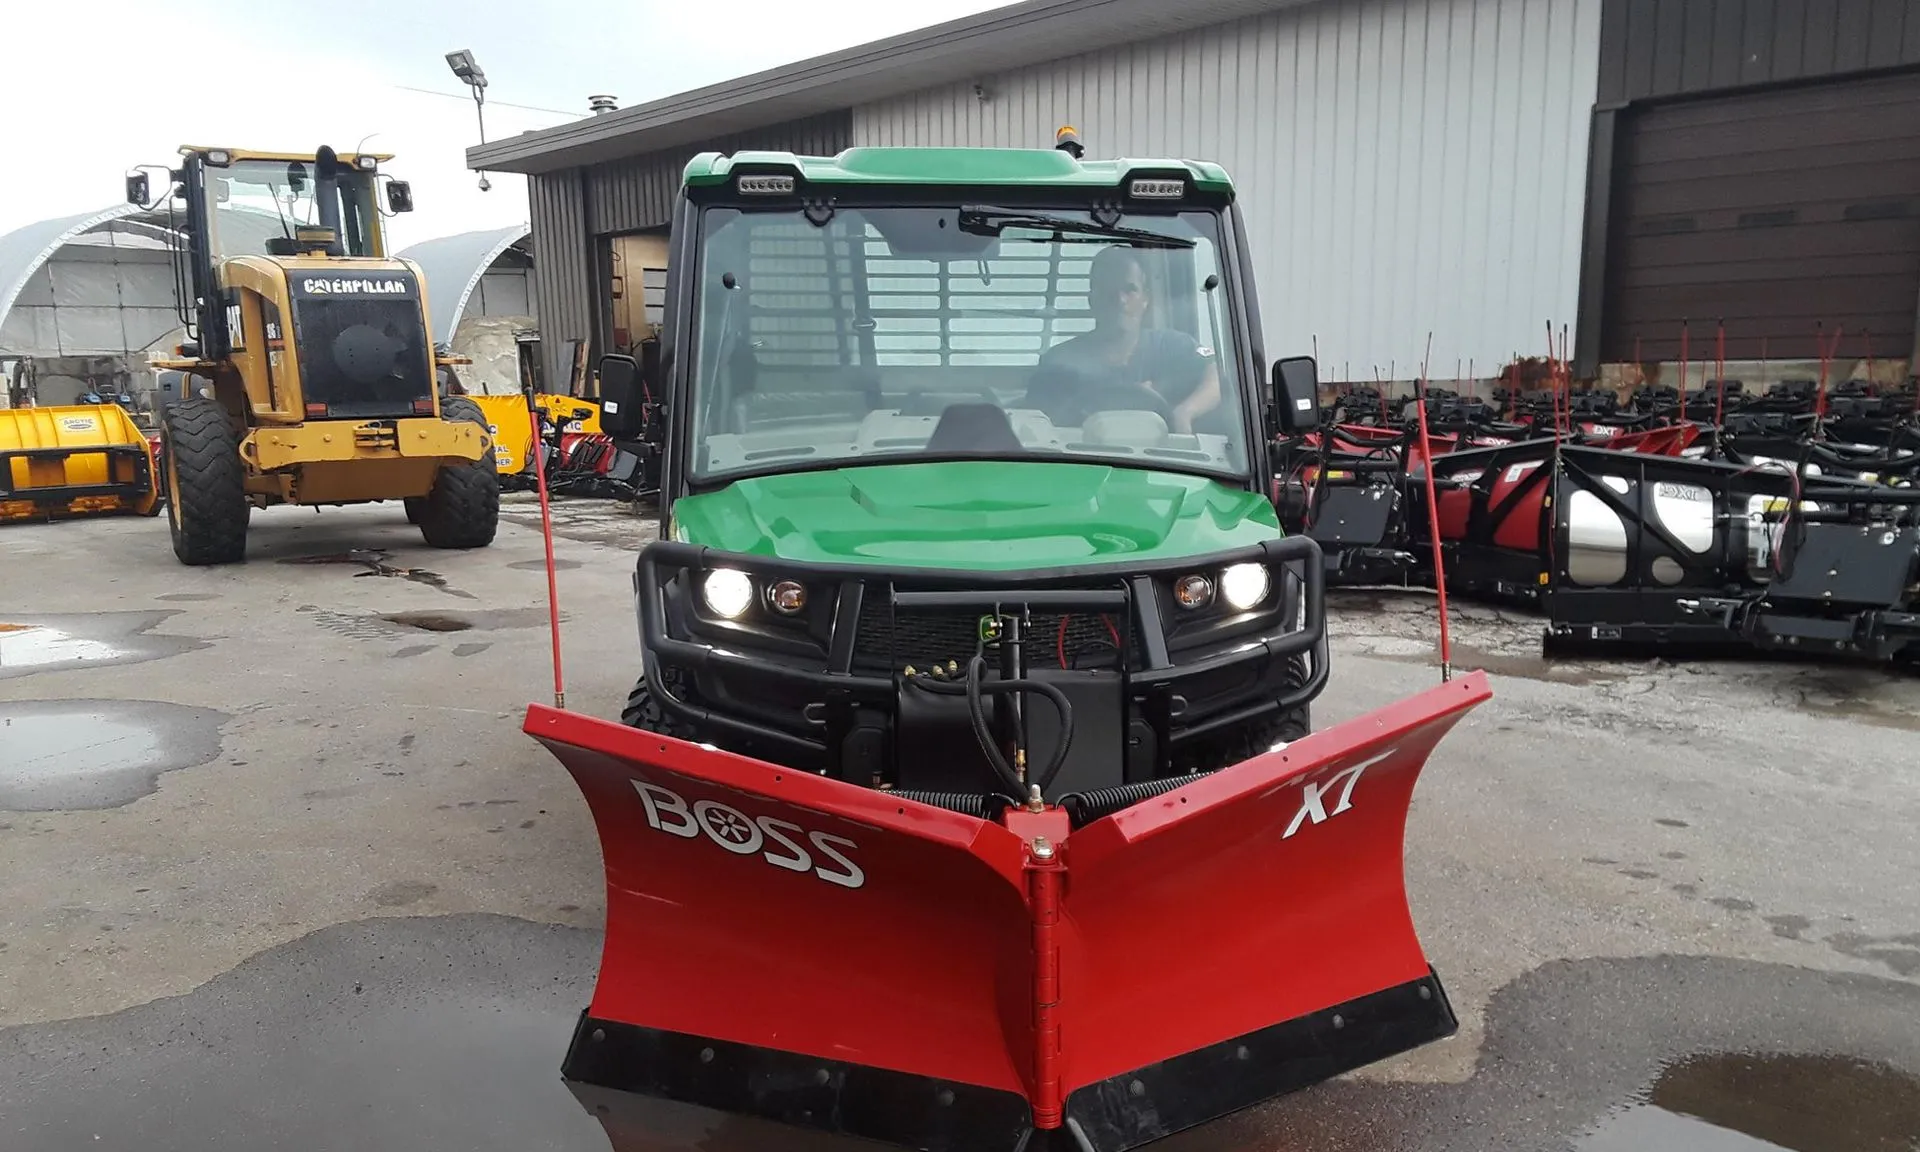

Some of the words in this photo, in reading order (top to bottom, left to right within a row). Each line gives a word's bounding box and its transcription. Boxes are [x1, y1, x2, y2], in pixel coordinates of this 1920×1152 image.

[303, 278, 405, 294] CATERPILLAR
[1592, 423, 1618, 437] DXT
[1281, 748, 1399, 839] XT
[629, 779, 865, 888] BOSS
